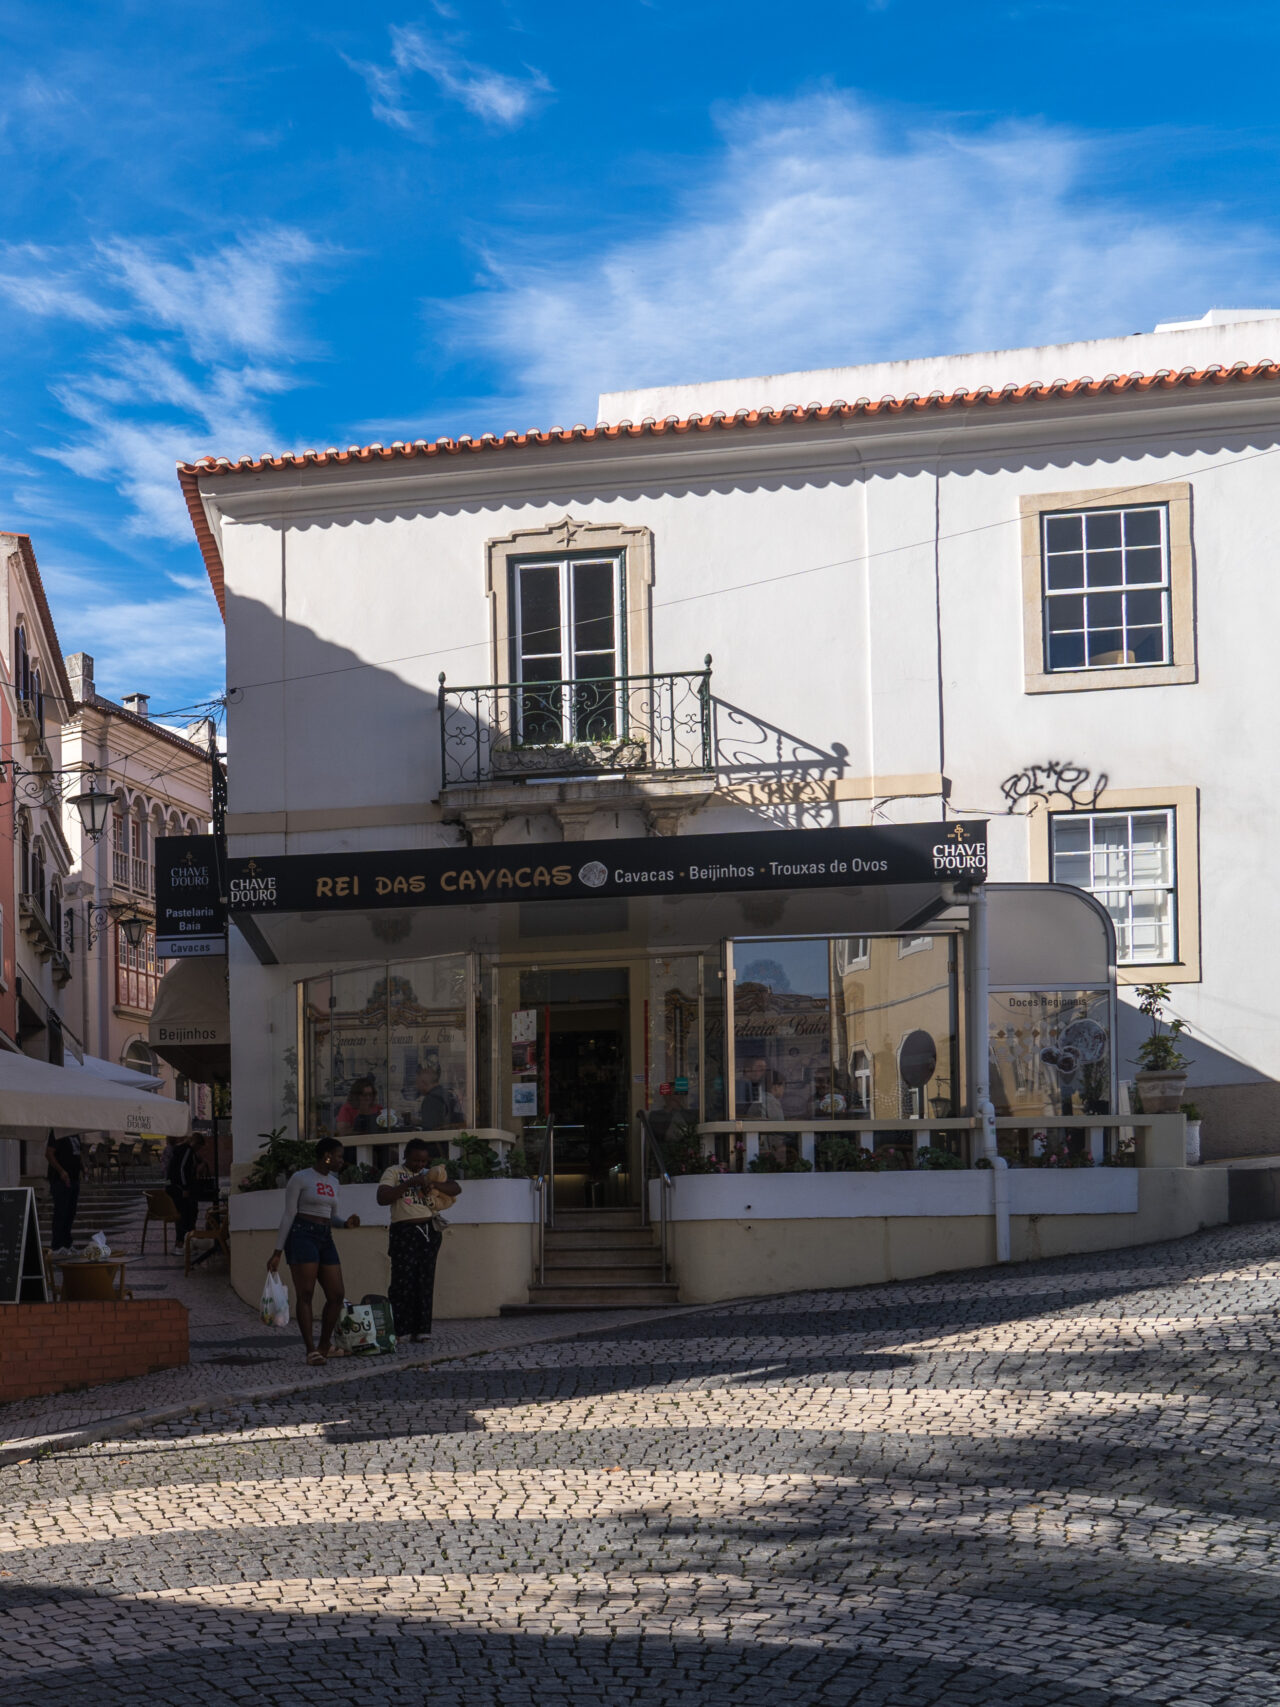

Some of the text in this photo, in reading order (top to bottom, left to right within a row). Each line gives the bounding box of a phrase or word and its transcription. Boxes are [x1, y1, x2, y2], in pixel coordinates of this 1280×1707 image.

[933, 843, 986, 857] CHAVE
[932, 855, 986, 869] D'OURO
[170, 866, 208, 877] CHAVE
[614, 858, 888, 883] Cavacas Beijinhos Trouxas de Ovos
[171, 876, 209, 887] D'OURO
[230, 877, 276, 890] CHAVE
[316, 865, 573, 897] REI DAS CAVACAS
[231, 889, 277, 902] D'OURO
[165, 907, 214, 918] Pastelaria
[170, 943, 211, 953] Cavacas
[1009, 997, 1087, 1008] Doces Regionais
[159, 1027, 216, 1043] Beijinhos
[316, 1182, 335, 1198] 23
